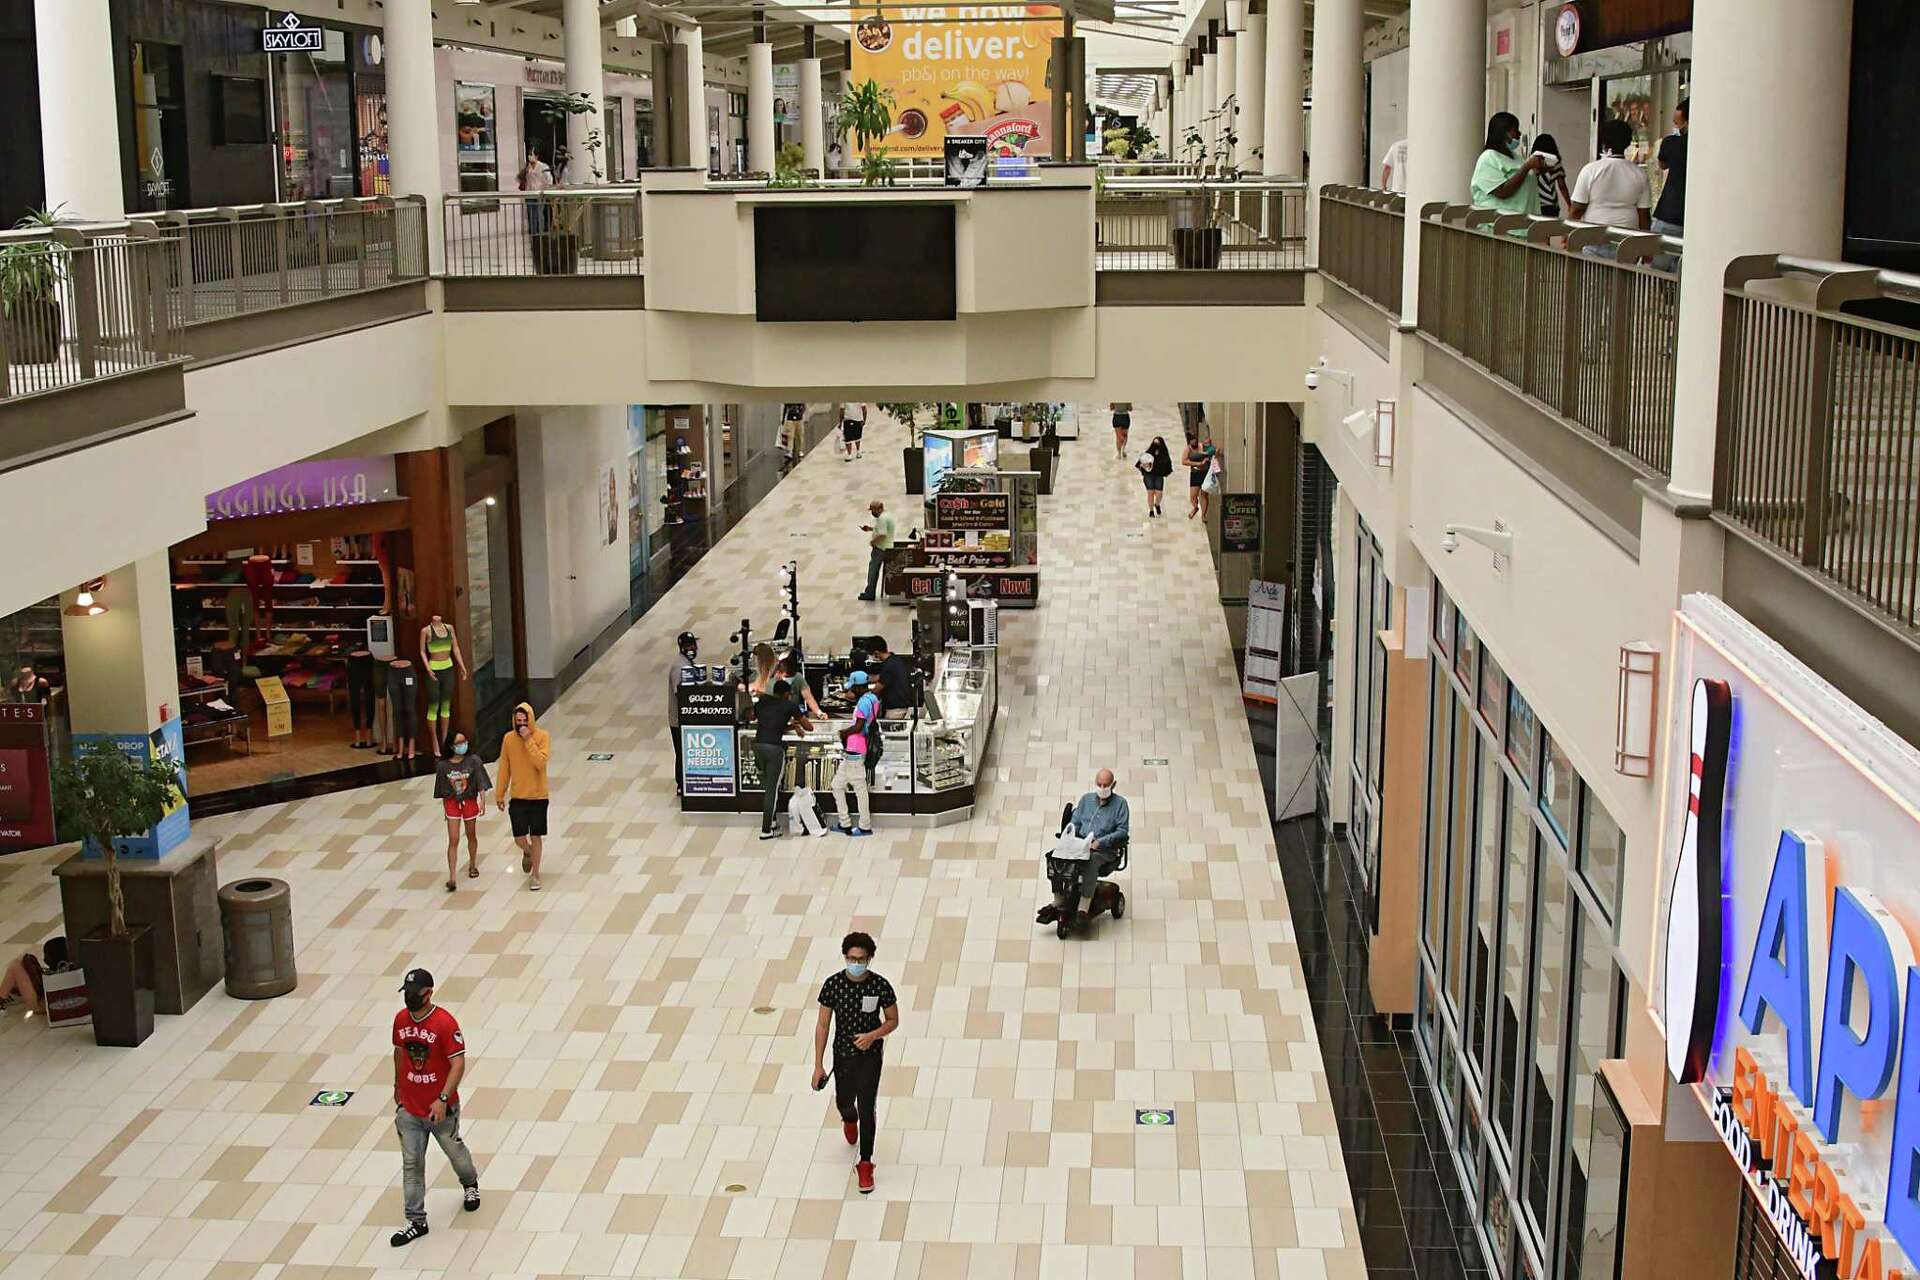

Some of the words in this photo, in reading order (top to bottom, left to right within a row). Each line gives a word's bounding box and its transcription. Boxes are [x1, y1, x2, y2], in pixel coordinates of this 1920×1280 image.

[901, 7, 946, 26] we
[958, 6, 1026, 27] now
[266, 32, 320, 48] SKYLOFT
[902, 30, 1025, 60] deliver.
[940, 70, 961, 81] on
[966, 66, 990, 81] the
[989, 122, 1032, 145] annaford
[323, 473, 368, 506] USA
[980, 498, 1006, 508] Gold
[928, 554, 945, 565] The
[947, 554, 967, 565] Best
[968, 554, 991, 565] Price
[912, 578, 931, 595] Get
[1000, 578, 1032, 595] Now!
[688, 694, 713, 703] GOLD
[713, 694, 725, 702] N
[681, 707, 733, 715] DIAMONDS
[116, 741, 145, 751] DROP
[687, 733, 716, 749] NO
[687, 748, 722, 758] CREDIT
[398, 1026, 437, 1043] BEAST
[1712, 1086, 1752, 1174] FOOD
[1732, 1045, 1904, 1280] ENTERTA
[1768, 1176, 1822, 1280] DRINK
